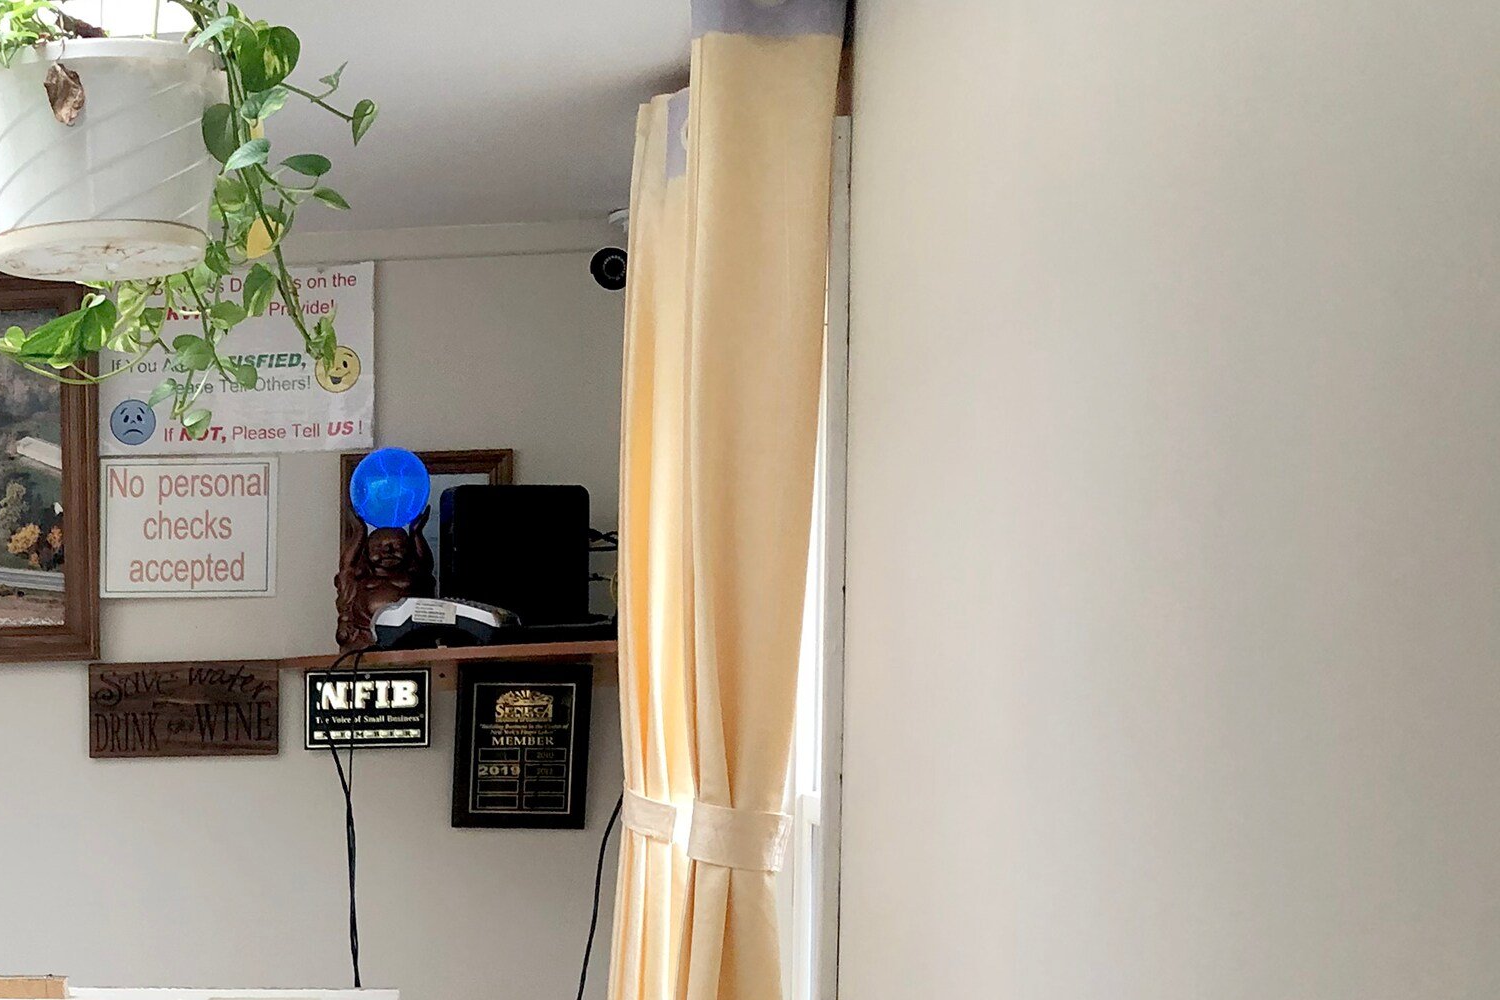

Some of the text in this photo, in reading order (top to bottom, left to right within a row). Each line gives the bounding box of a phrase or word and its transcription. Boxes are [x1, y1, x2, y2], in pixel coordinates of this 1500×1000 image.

[307, 277, 327, 289] on
[332, 274, 357, 287] the
[269, 299, 334, 316] Prvide!
[111, 359, 122, 373] If
[219, 378, 247, 393] Te
[254, 376, 311, 392] Others!
[164, 428, 174, 442] If
[232, 426, 287, 441] Please
[291, 423, 320, 438] Tell
[109, 466, 269, 505] No personal
[143, 509, 232, 540] checks
[128, 552, 245, 589] accepted
[316, 680, 419, 710] NFIB
[495, 703, 553, 718] SENECA
[94, 700, 272, 752] DRINK WINE
[332, 716, 351, 724] Voice
[363, 715, 385, 723] Small
[491, 736, 555, 746] MEMBER
[478, 765, 521, 776] 2019
